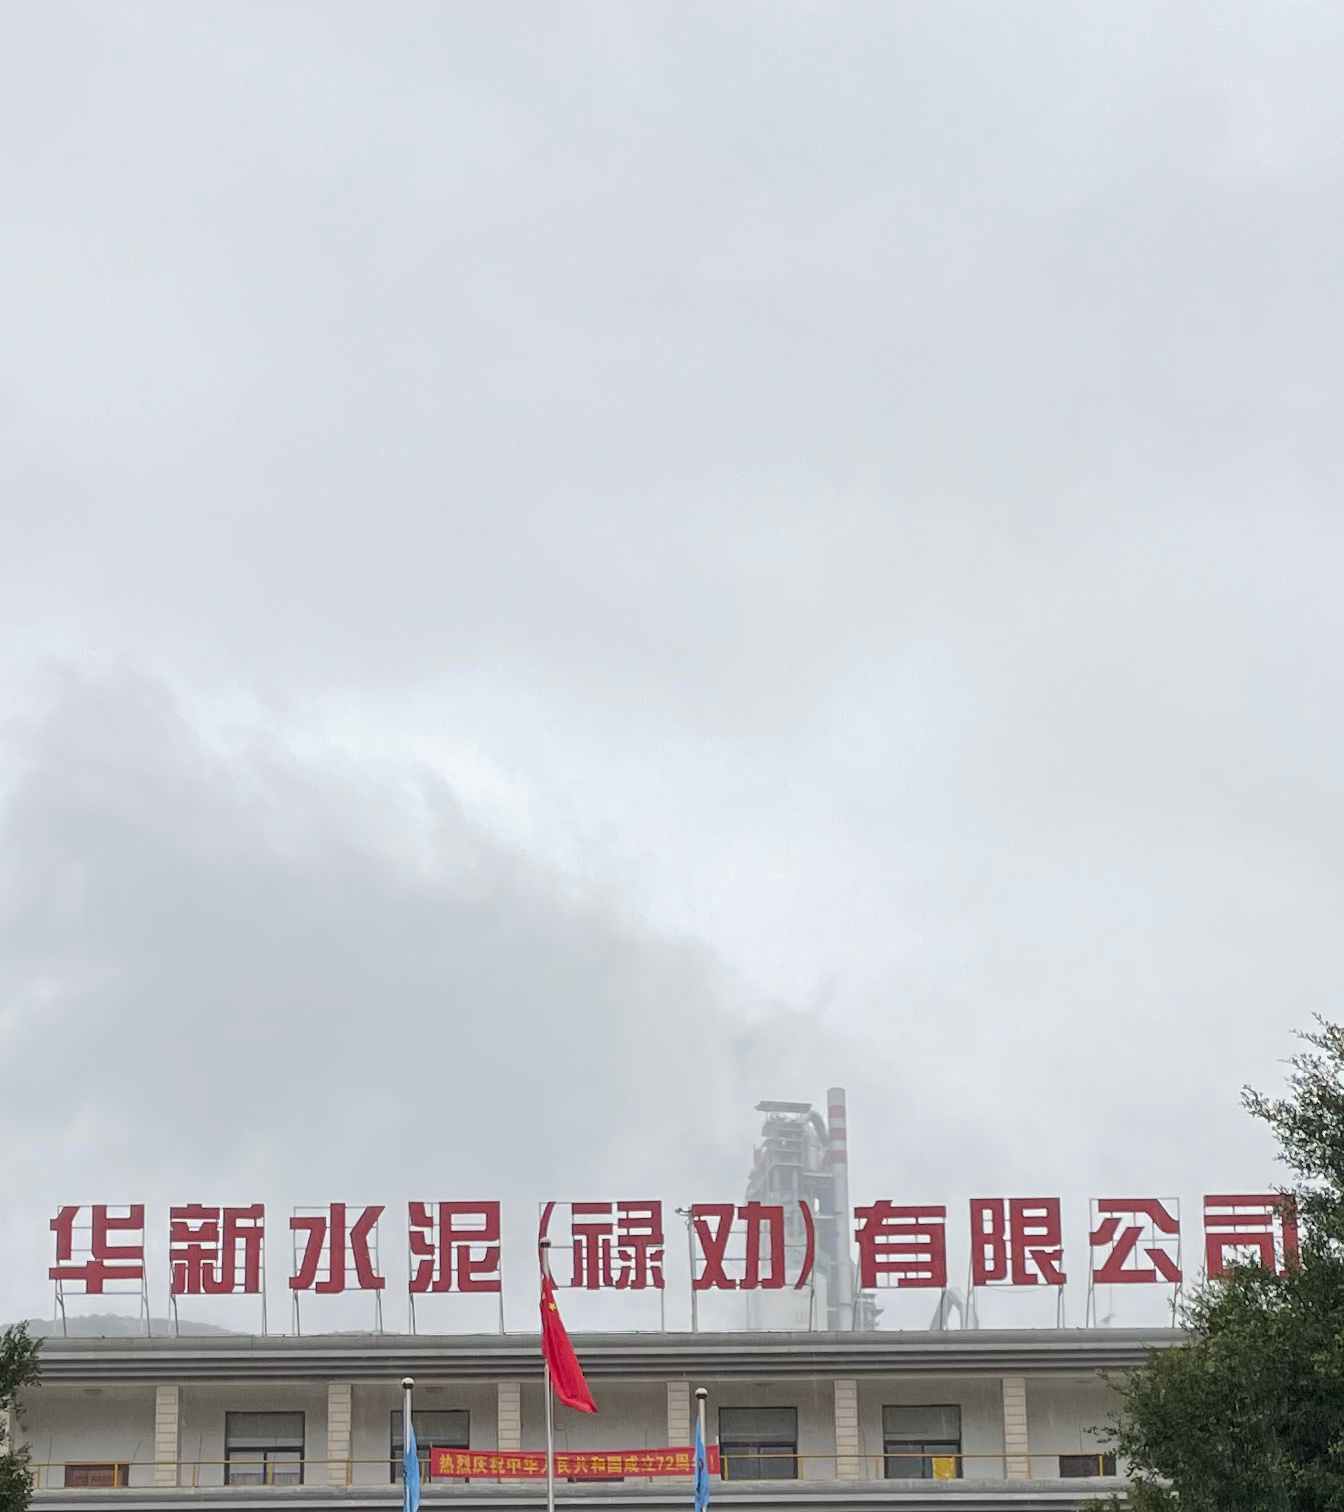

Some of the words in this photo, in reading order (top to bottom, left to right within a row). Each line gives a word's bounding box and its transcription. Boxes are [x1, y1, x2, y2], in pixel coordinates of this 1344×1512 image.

[49, 1195, 1300, 1295] 华新水泥(禄劝)有限公司
[439, 1453, 714, 1475] 热烈庆祝中华民共和国成立72周!
